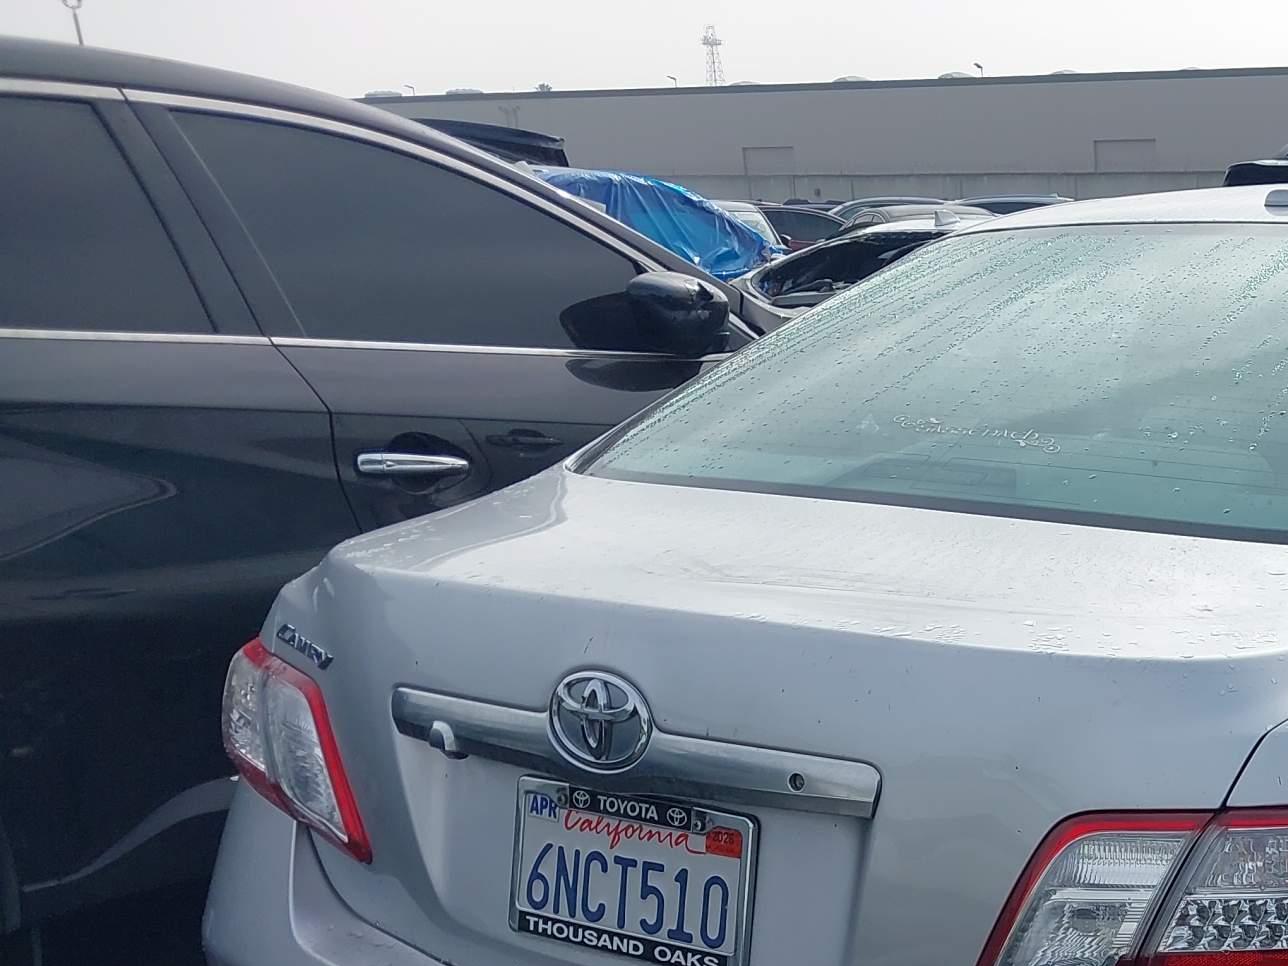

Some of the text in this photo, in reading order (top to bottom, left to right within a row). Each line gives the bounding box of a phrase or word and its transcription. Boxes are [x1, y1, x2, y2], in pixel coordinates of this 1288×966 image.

[529, 794, 558, 819] APR
[597, 796, 658, 821] TOYOTA
[564, 809, 706, 854] California
[526, 843, 730, 949] 6NCT510
[526, 915, 644, 956] THOUSAND
